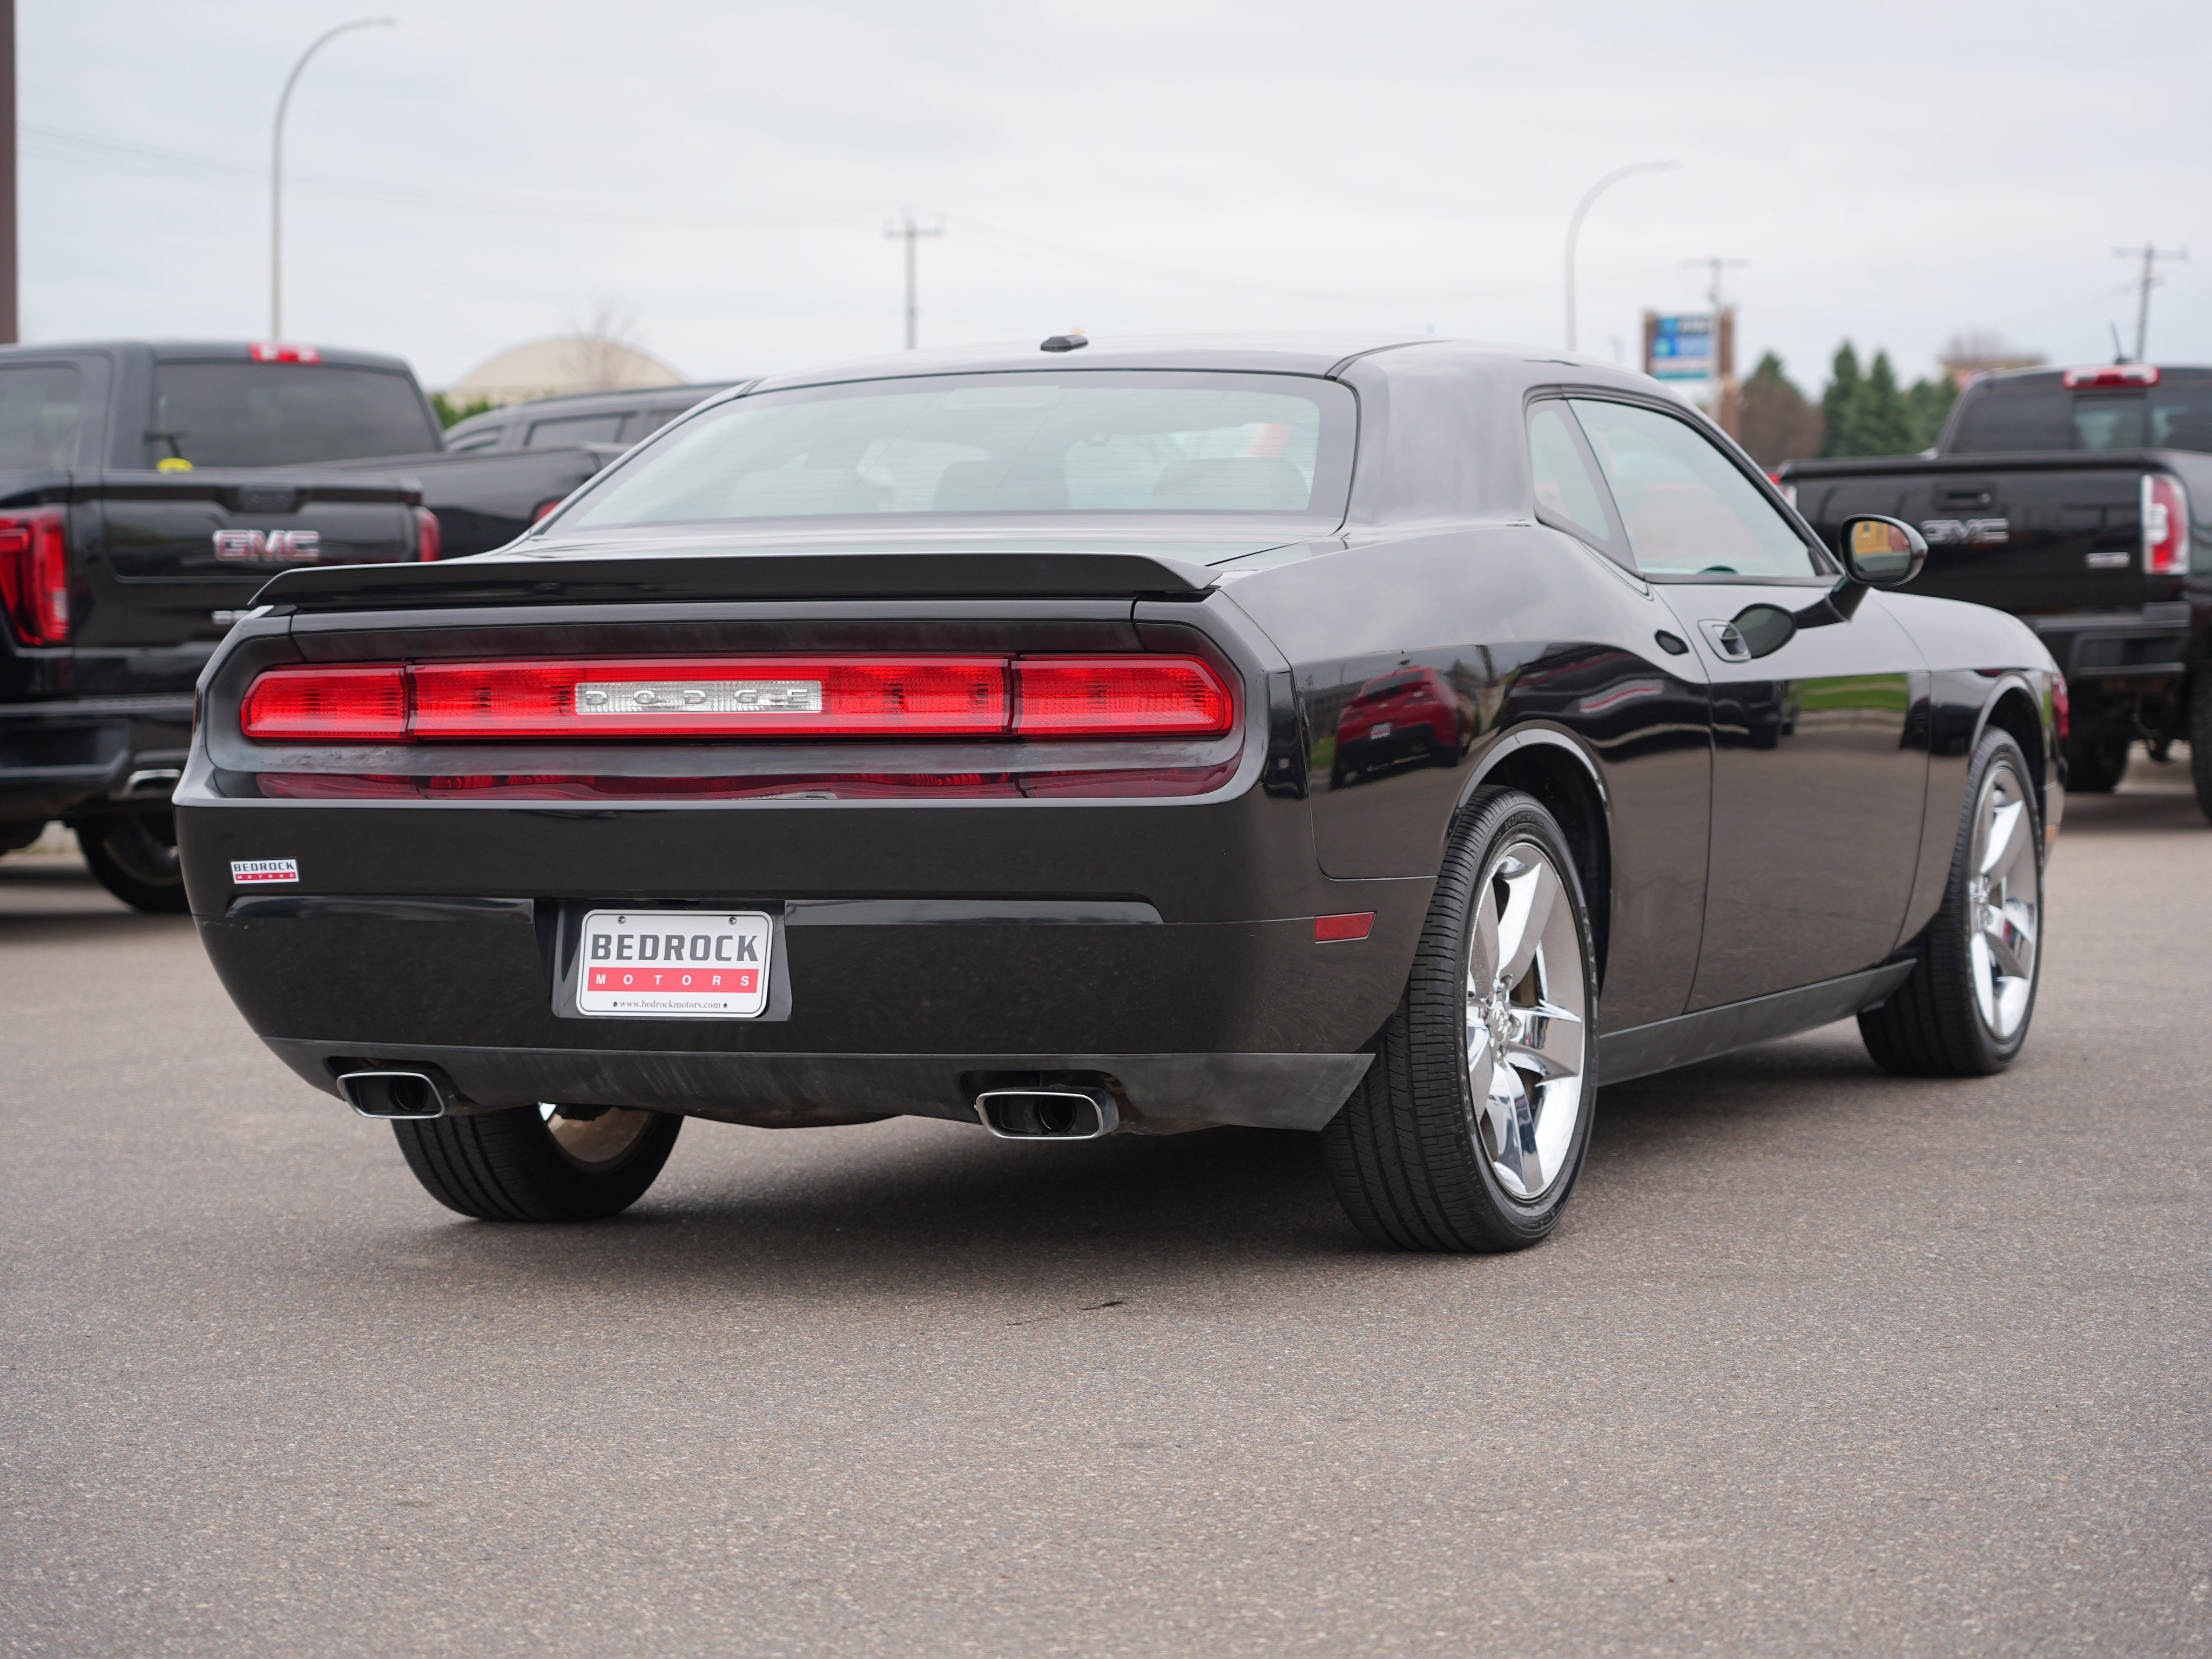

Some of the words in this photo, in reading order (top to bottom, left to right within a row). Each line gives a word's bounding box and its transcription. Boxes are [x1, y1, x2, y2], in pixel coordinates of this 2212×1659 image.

[1920, 518, 2009, 543] GMC
[213, 529, 320, 561] GMC
[586, 689, 809, 704] DODGE
[234, 862, 294, 872] BEDROCK
[591, 934, 759, 961] BEDROCK
[596, 974, 750, 986] MOTORS
[620, 1000, 721, 1009] www.bedrockmotors.com
